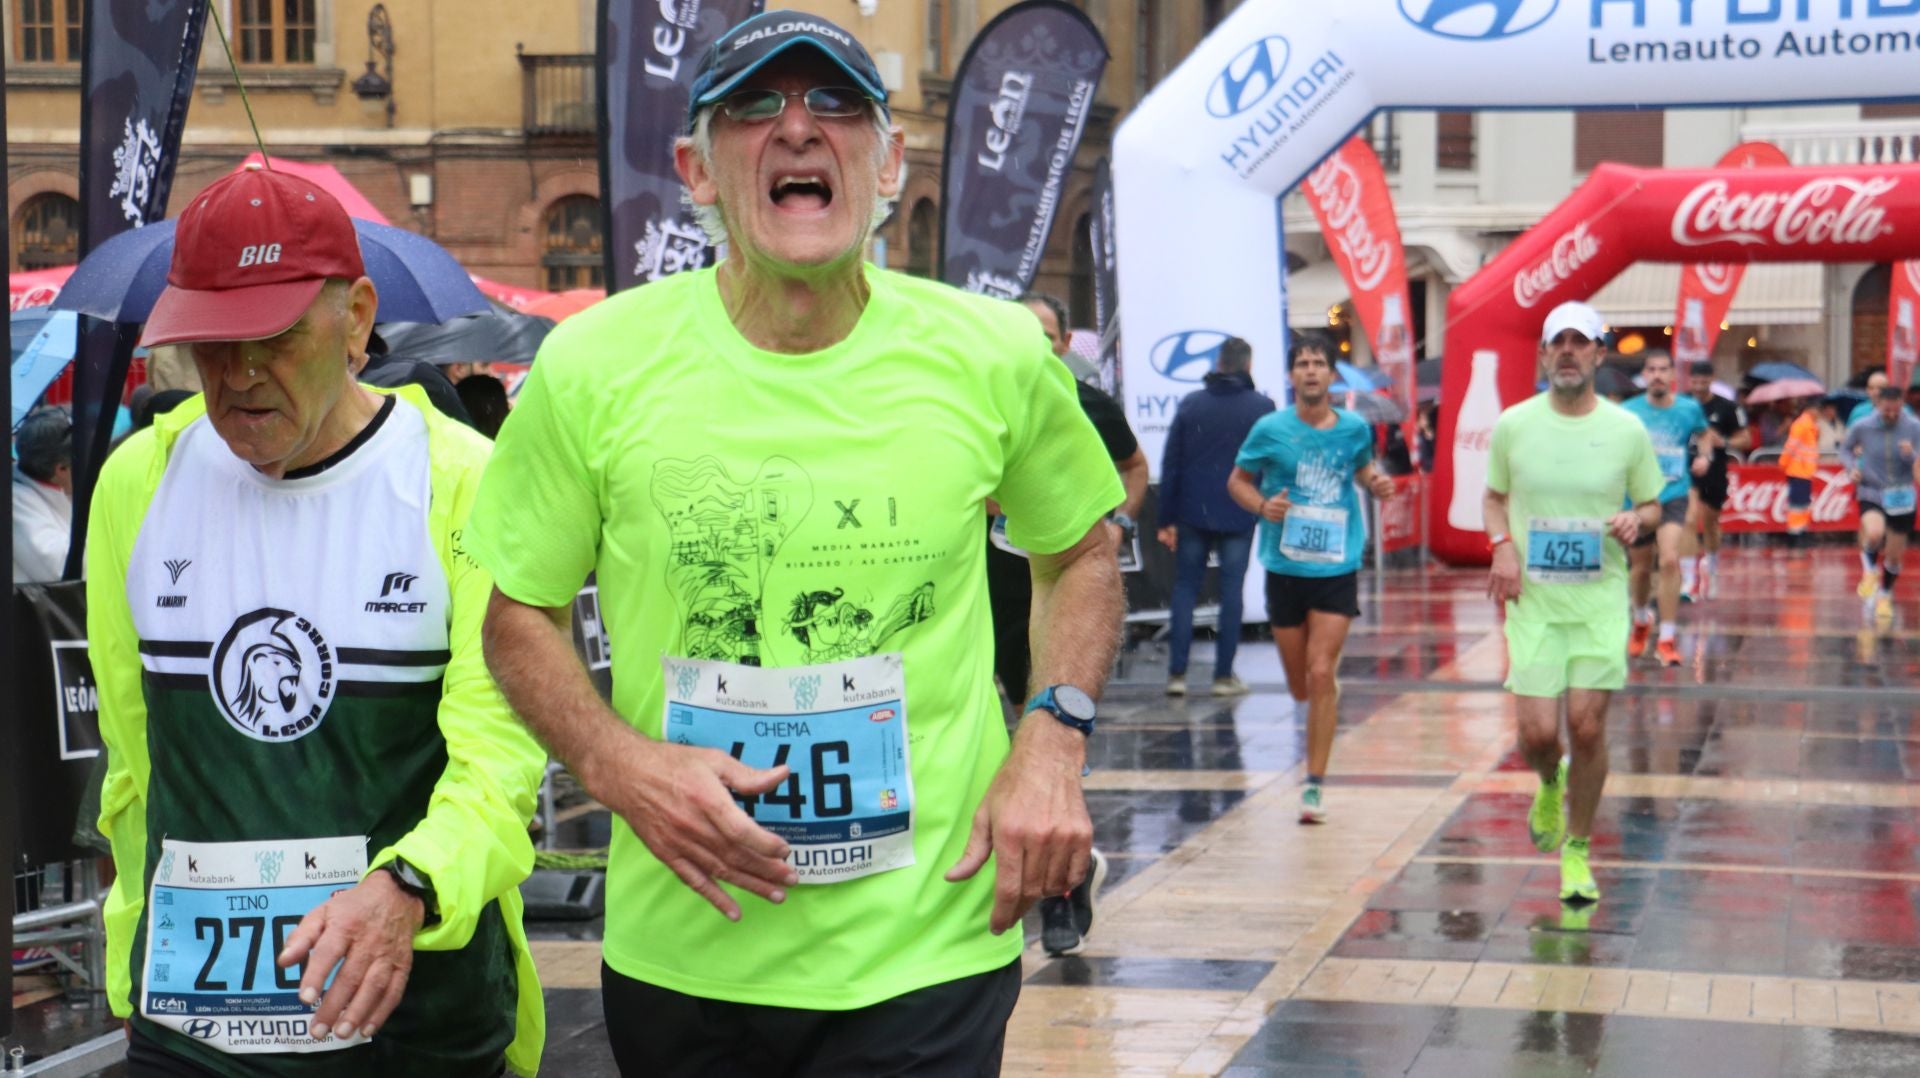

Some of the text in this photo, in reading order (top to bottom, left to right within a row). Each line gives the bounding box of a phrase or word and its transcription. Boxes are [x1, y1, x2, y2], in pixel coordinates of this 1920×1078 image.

[734, 22, 850, 50] SALOMON
[1589, 29, 1920, 63] Lemauto Autom
[1221, 50, 1344, 170] HYUNDAI
[1238, 135, 1288, 180] Lemauto
[1017, 154, 1066, 282] AYUNTAMIENTO
[1057, 128, 1072, 151] DE
[1671, 176, 1900, 247] Coca-Cola
[238, 242, 282, 268] BIG
[1513, 221, 1602, 308] Coca-Cola
[861, 539, 919, 549] MARATÓN
[1300, 526, 1329, 550] 381
[1543, 540, 1584, 566] 425
[786, 560, 841, 568] RIBADEO
[365, 602, 427, 613] MARCET
[717, 674, 727, 694] k
[843, 673, 855, 691] k
[716, 697, 769, 710] kutxabank
[843, 686, 896, 704] kutxabank
[754, 721, 811, 738] CHEMA
[188, 855, 198, 872] k
[305, 852, 317, 869] k
[793, 845, 872, 867] UNDAI
[305, 869, 359, 880] kutxabank
[806, 861, 872, 876] Automoción
[189, 874, 235, 884] kutxabank
[226, 895, 269, 911] TINO
[228, 1020, 308, 1037] HYUND
[228, 1037, 272, 1047] Lemauto
